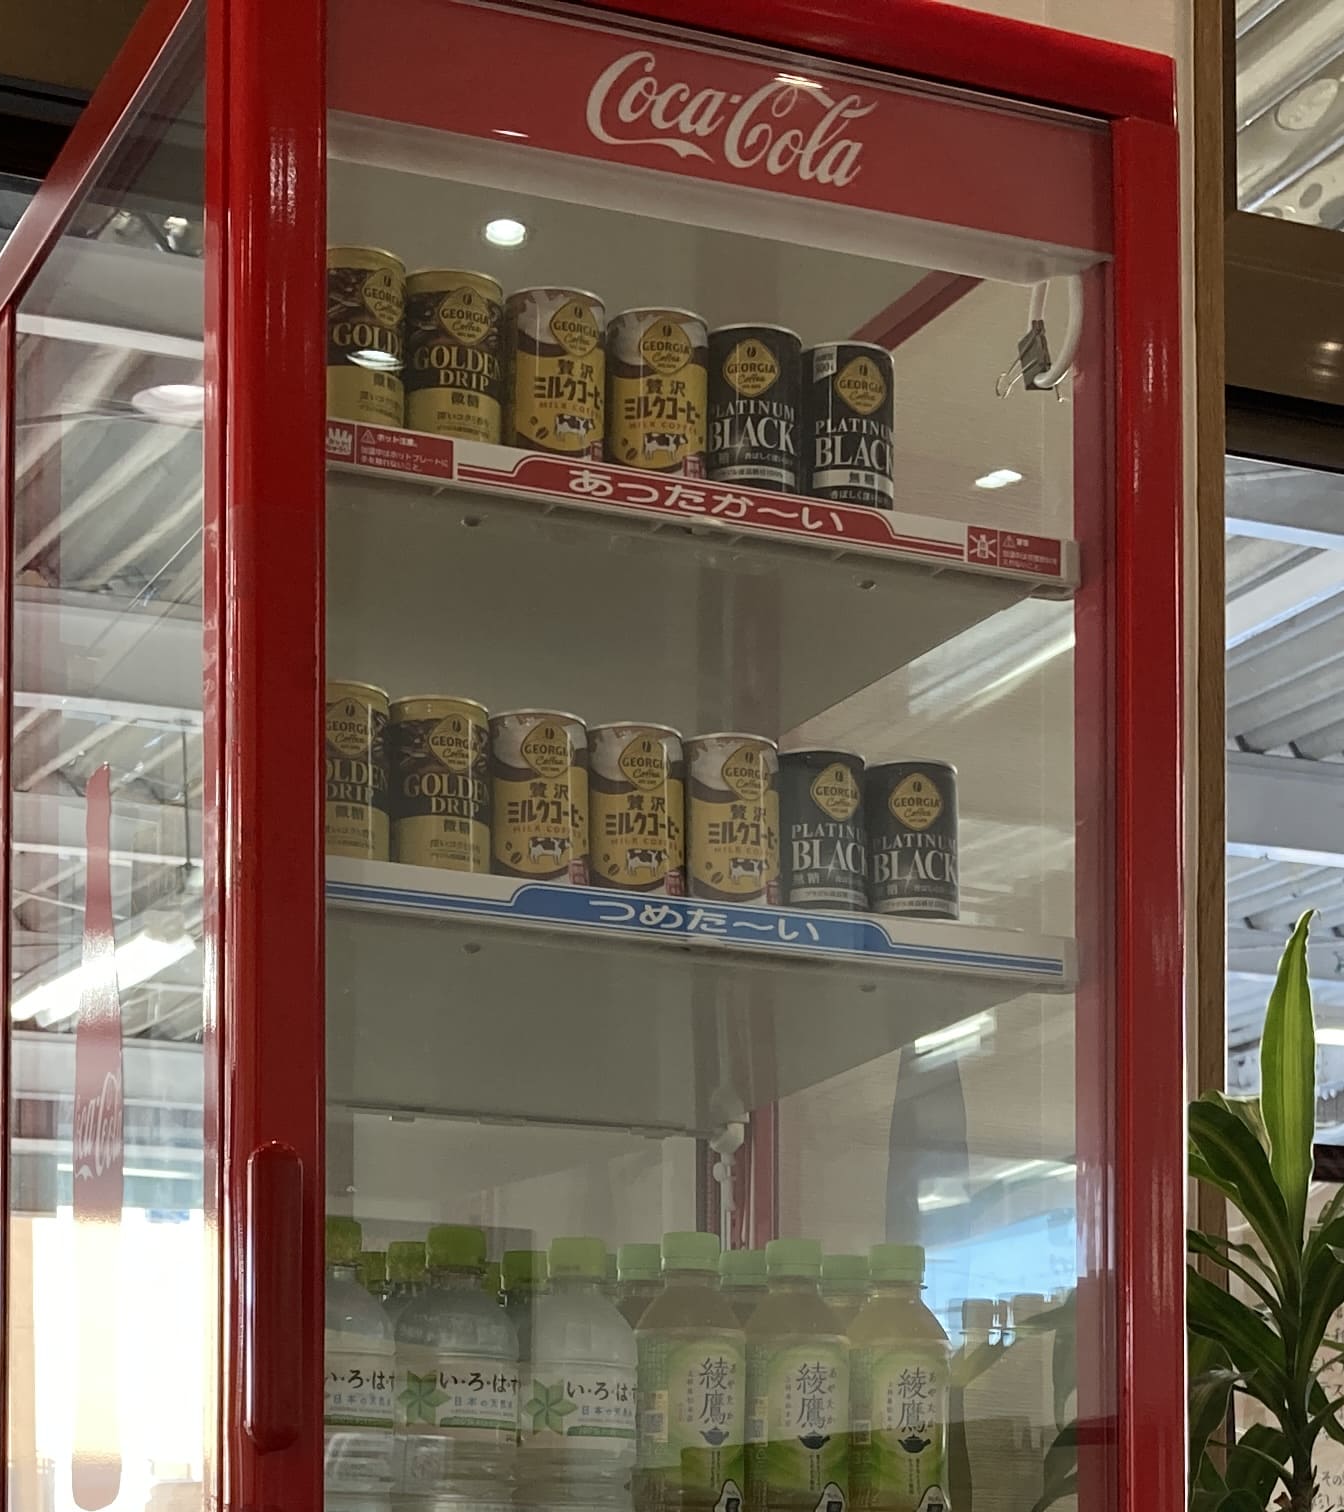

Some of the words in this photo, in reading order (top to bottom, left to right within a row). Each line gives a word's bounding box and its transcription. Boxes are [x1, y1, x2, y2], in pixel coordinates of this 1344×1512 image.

[586, 51, 877, 187] Coca-Cola
[333, 322, 403, 358] GOLD
[439, 369, 489, 391] DRIP
[727, 362, 777, 376] GEORGIA
[816, 420, 894, 447] PLATINU
[325, 758, 387, 793] OLDEN
[894, 797, 940, 809] GEORGIA
[792, 823, 865, 842] PLATIN
[873, 833, 956, 850] LATINU
[792, 840, 865, 875] BLAC
[874, 850, 957, 886] BLACK
[699, 1356, 729, 1426] 綾鷹
[796, 1362, 828, 1429] 綾鷹
[897, 1367, 928, 1434] 綾鷹
